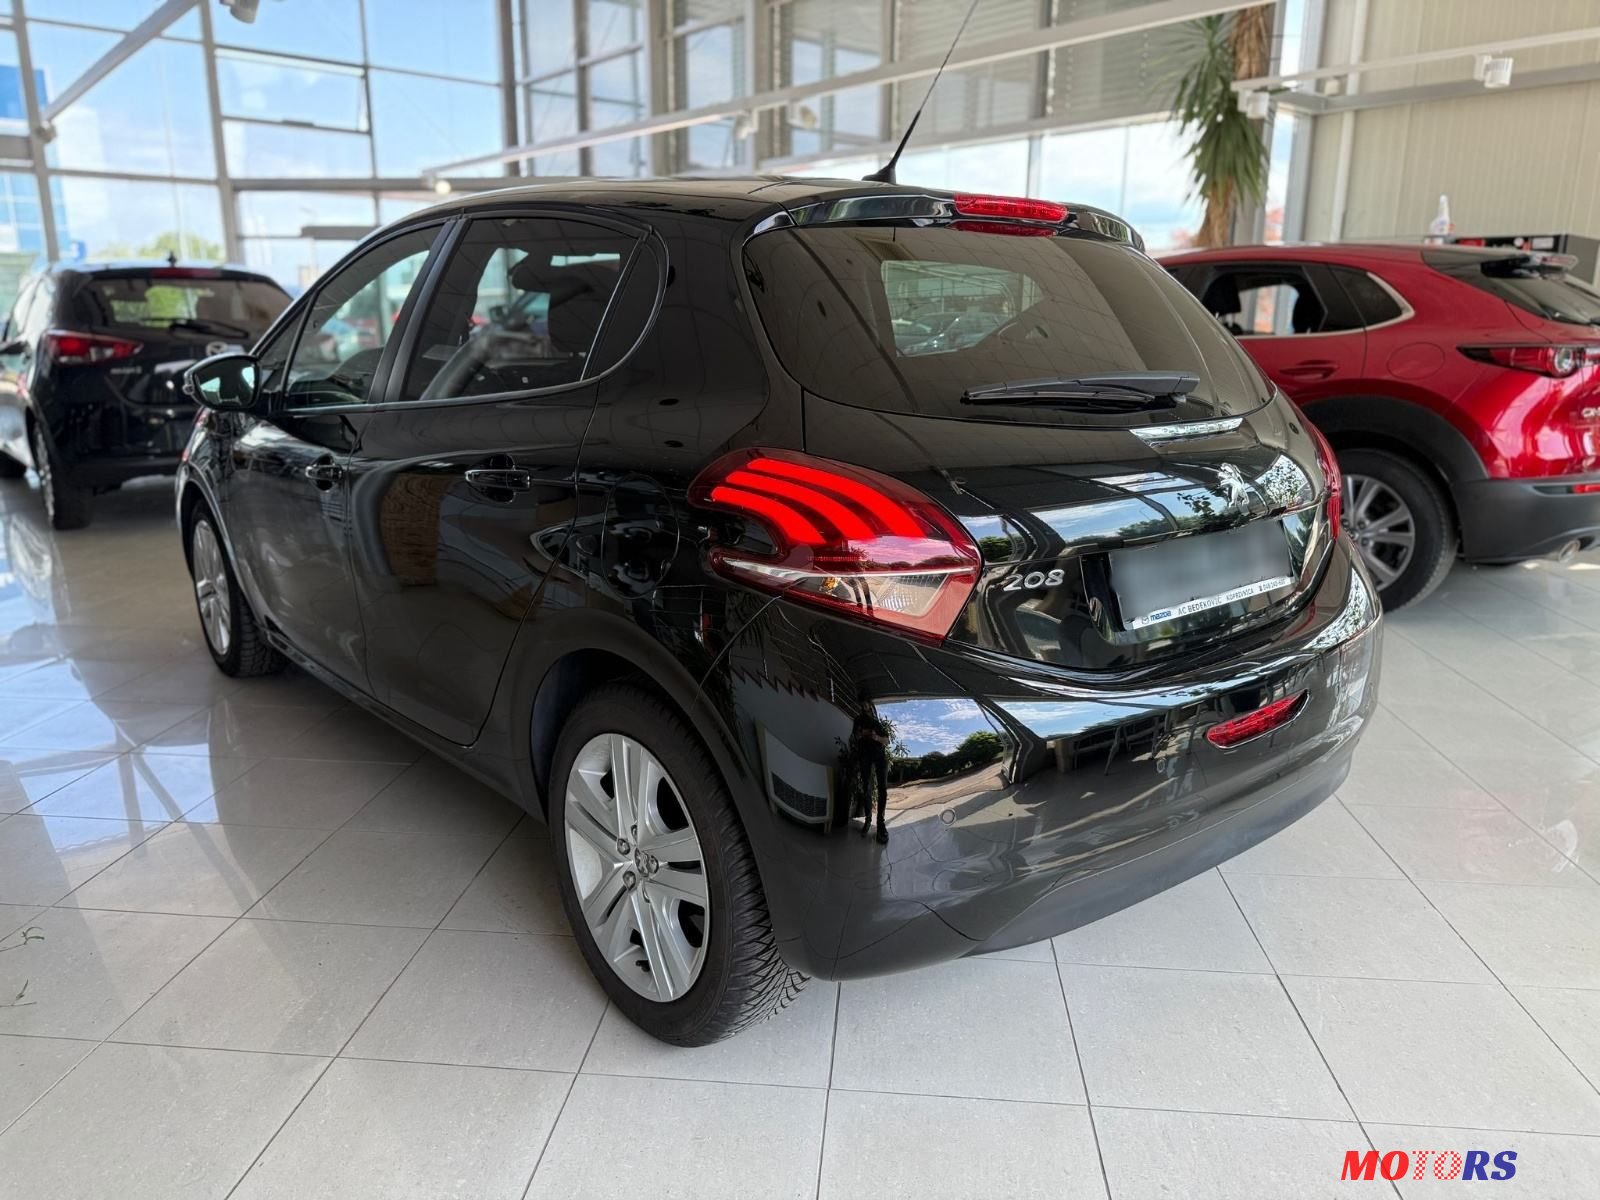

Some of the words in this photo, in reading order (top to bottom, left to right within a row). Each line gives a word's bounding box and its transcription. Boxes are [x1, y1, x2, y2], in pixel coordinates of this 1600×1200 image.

[1003, 569, 1065, 591] 208
[1150, 610, 1172, 622] mazda
[1178, 607, 1187, 615] AC
